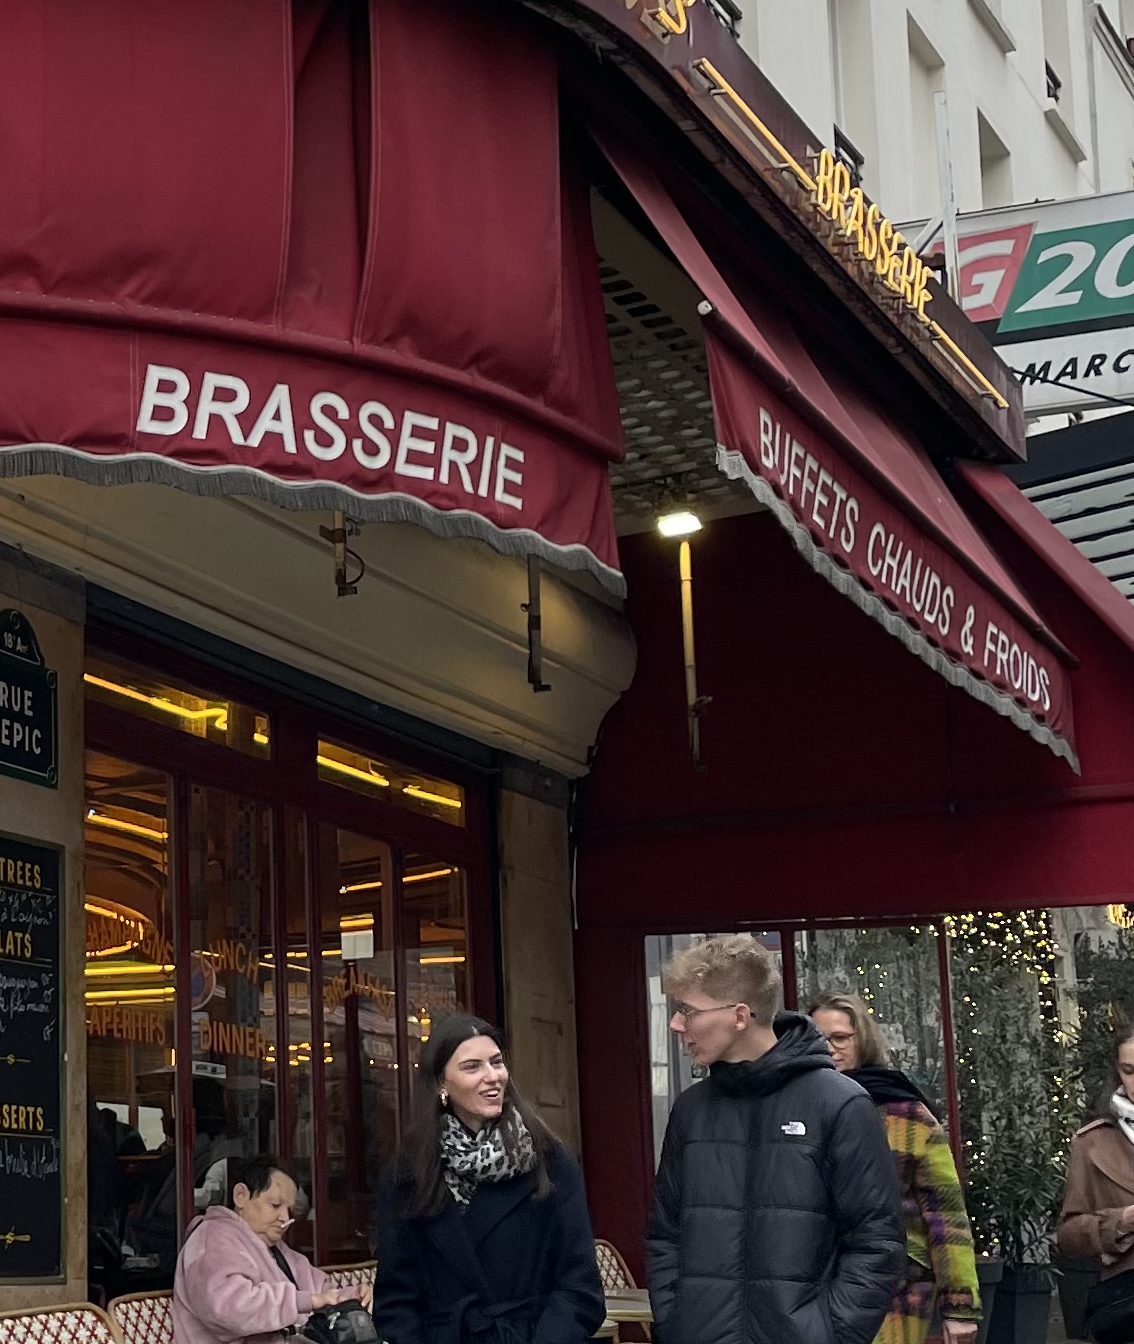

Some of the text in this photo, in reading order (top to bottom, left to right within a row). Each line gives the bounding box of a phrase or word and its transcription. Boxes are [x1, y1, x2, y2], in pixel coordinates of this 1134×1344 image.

[815, 147, 934, 323] BRASSERIE
[135, 363, 527, 512] BRASSERIE
[758, 406, 1051, 711] BUFFETS CHAUDS & FROIDS
[0, 680, 34, 717] RUE
[199, 1018, 267, 1059] DINNER
